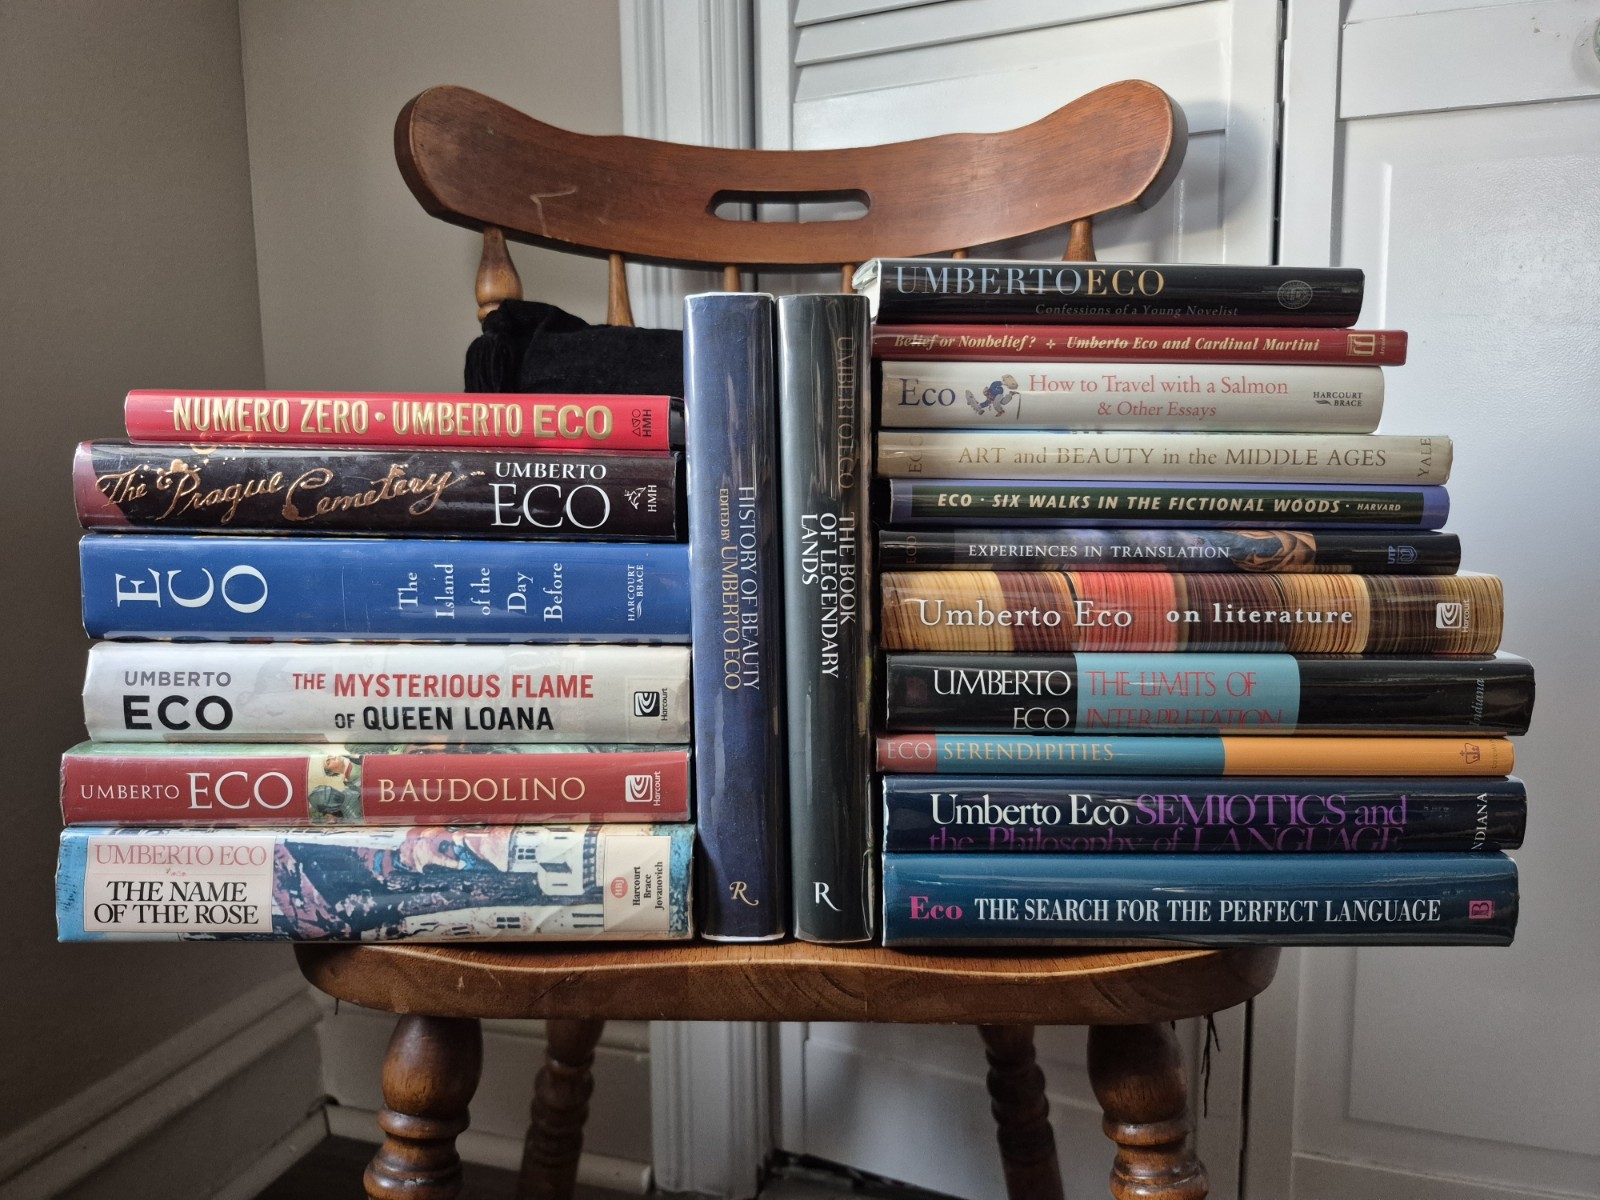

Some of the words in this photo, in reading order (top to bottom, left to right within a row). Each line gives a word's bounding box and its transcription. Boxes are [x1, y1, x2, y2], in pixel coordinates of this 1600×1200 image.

[1035, 303, 1111, 316] Confessions
[1115, 303, 1130, 315] of
[1142, 305, 1182, 319] Young
[1186, 305, 1239, 316] Novelist
[894, 334, 937, 350] Belief
[939, 337, 956, 348] or
[1066, 336, 1128, 349] Umberto
[1132, 337, 1158, 350] Eco
[1162, 337, 1190, 350] and
[1195, 337, 1259, 351] Cardinal
[1262, 338, 1320, 351] Martini
[898, 377, 956, 406] Eco
[1029, 374, 1076, 392] How
[1080, 377, 1098, 392] to
[1102, 374, 1156, 393] Travel
[1160, 376, 1201, 393] with
[1206, 383, 1216, 394] a
[1220, 376, 1288, 395] Salmon
[1313, 391, 1363, 399] HARCOURT
[174, 397, 290, 433] NUMERO
[300, 399, 369, 434] ZERO
[392, 401, 523, 437] UMBERTO
[533, 404, 614, 440] ECO
[642, 408, 653, 437] HMH
[1097, 402, 1112, 416] &
[1116, 400, 1164, 417] Other
[1167, 402, 1217, 421] Essays
[495, 462, 607, 480] UMBERTO
[958, 447, 1006, 465] ART
[1014, 447, 1047, 465] and
[1057, 447, 1155, 465] BEAUTY
[1162, 447, 1179, 465] in
[1188, 447, 1217, 465] the
[1226, 448, 1318, 466] MIDDLE
[1326, 449, 1386, 467] AGES
[1417, 437, 1432, 477] YALE
[95, 464, 148, 509] The
[156, 459, 285, 524] Prague
[281, 463, 472, 521] Cemetery
[488, 483, 611, 529] ECO
[647, 484, 657, 512] HMH
[937, 494, 973, 507] ECO
[992, 494, 1021, 508] SIX
[1029, 495, 1090, 509] WALKS
[1098, 496, 1118, 509] IN
[1127, 496, 1161, 510] THE
[1168, 498, 1265, 512] FICTIONAL
[1274, 499, 1340, 513] WOODS
[1356, 503, 1401, 512] HARVARD
[719, 488, 730, 527] EDITED
[720, 529, 731, 542] BY
[738, 486, 757, 574] HISTORY
[819, 512, 837, 542] OF
[839, 512, 855, 556] THE
[801, 514, 819, 585] LANDS
[969, 545, 1078, 557] EXPERIENCES
[1084, 545, 1102, 557] IN
[1110, 546, 1230, 559] TRANSLATION
[1387, 545, 1395, 564] UTP
[398, 572, 418, 610] The
[433, 563, 455, 620] Island
[469, 567, 490, 594] the
[507, 571, 534, 613] Day
[543, 562, 563, 622] Before
[627, 564, 635, 621] HARCOURT
[636, 564, 644, 597] BRACE
[721, 545, 740, 644] UMBERTO
[740, 579, 757, 606] OF
[840, 564, 856, 625] BOOK
[469, 597, 490, 616] of
[820, 549, 839, 678] LEGENDARY
[918, 599, 1061, 628] Umberto
[1073, 599, 1133, 628] Eco
[1166, 608, 1202, 623] on
[1213, 603, 1353, 623] literature
[1461, 599, 1470, 633] Harcourt
[741, 614, 759, 690] BEAUTY
[124, 671, 232, 687] UMBERTO
[724, 648, 741, 690] ECO
[933, 669, 1072, 696] UMBERTO
[1084, 671, 1132, 696] THE
[1140, 671, 1217, 696] LIMITS
[1226, 671, 1257, 696] OF
[292, 673, 326, 690] THE
[334, 673, 500, 698] MYSTERIOUS
[512, 674, 594, 698] FLAME
[122, 695, 234, 731] ECO
[660, 688, 668, 721] Harcourt
[1469, 679, 1485, 727] Indiana
[334, 714, 355, 729] OF
[363, 705, 453, 731] QUEEN
[465, 707, 554, 730] LOANA
[1013, 707, 1070, 729] ECO
[1086, 708, 1284, 729] INTERPRETATION
[887, 742, 932, 759] ECO
[943, 743, 1114, 761] SERENDIPITIES
[80, 784, 180, 800] UMBERTO
[187, 771, 293, 810] ECO
[378, 777, 586, 802] BAUDOLINO
[653, 770, 661, 806] Harcourt
[929, 793, 1061, 826] Umberto
[1068, 794, 1129, 826] Eco
[1135, 794, 1346, 826] SEMIOTICS
[1354, 795, 1407, 826] and
[929, 827, 974, 851] the
[1152, 827, 1184, 851] of
[1193, 827, 1404, 851] LANGUAGE
[94, 844, 214, 866] UMBERTO
[219, 845, 267, 866] ECO
[106, 880, 163, 902] THE
[170, 881, 248, 902] NAME
[632, 866, 641, 906] Harcourt
[643, 874, 652, 898] Brace
[654, 861, 665, 911] Jovanovich
[94, 904, 126, 924] OF
[132, 904, 189, 924] THE
[194, 905, 260, 925] ROSE
[909, 896, 963, 920] Eco
[974, 898, 1019, 921] THE
[1024, 898, 1110, 922] SEARCH
[1115, 899, 1160, 922] FOR
[1166, 899, 1211, 922] THE
[1218, 900, 1319, 922] PERFECT
[1325, 900, 1441, 922] LANGUAGE
